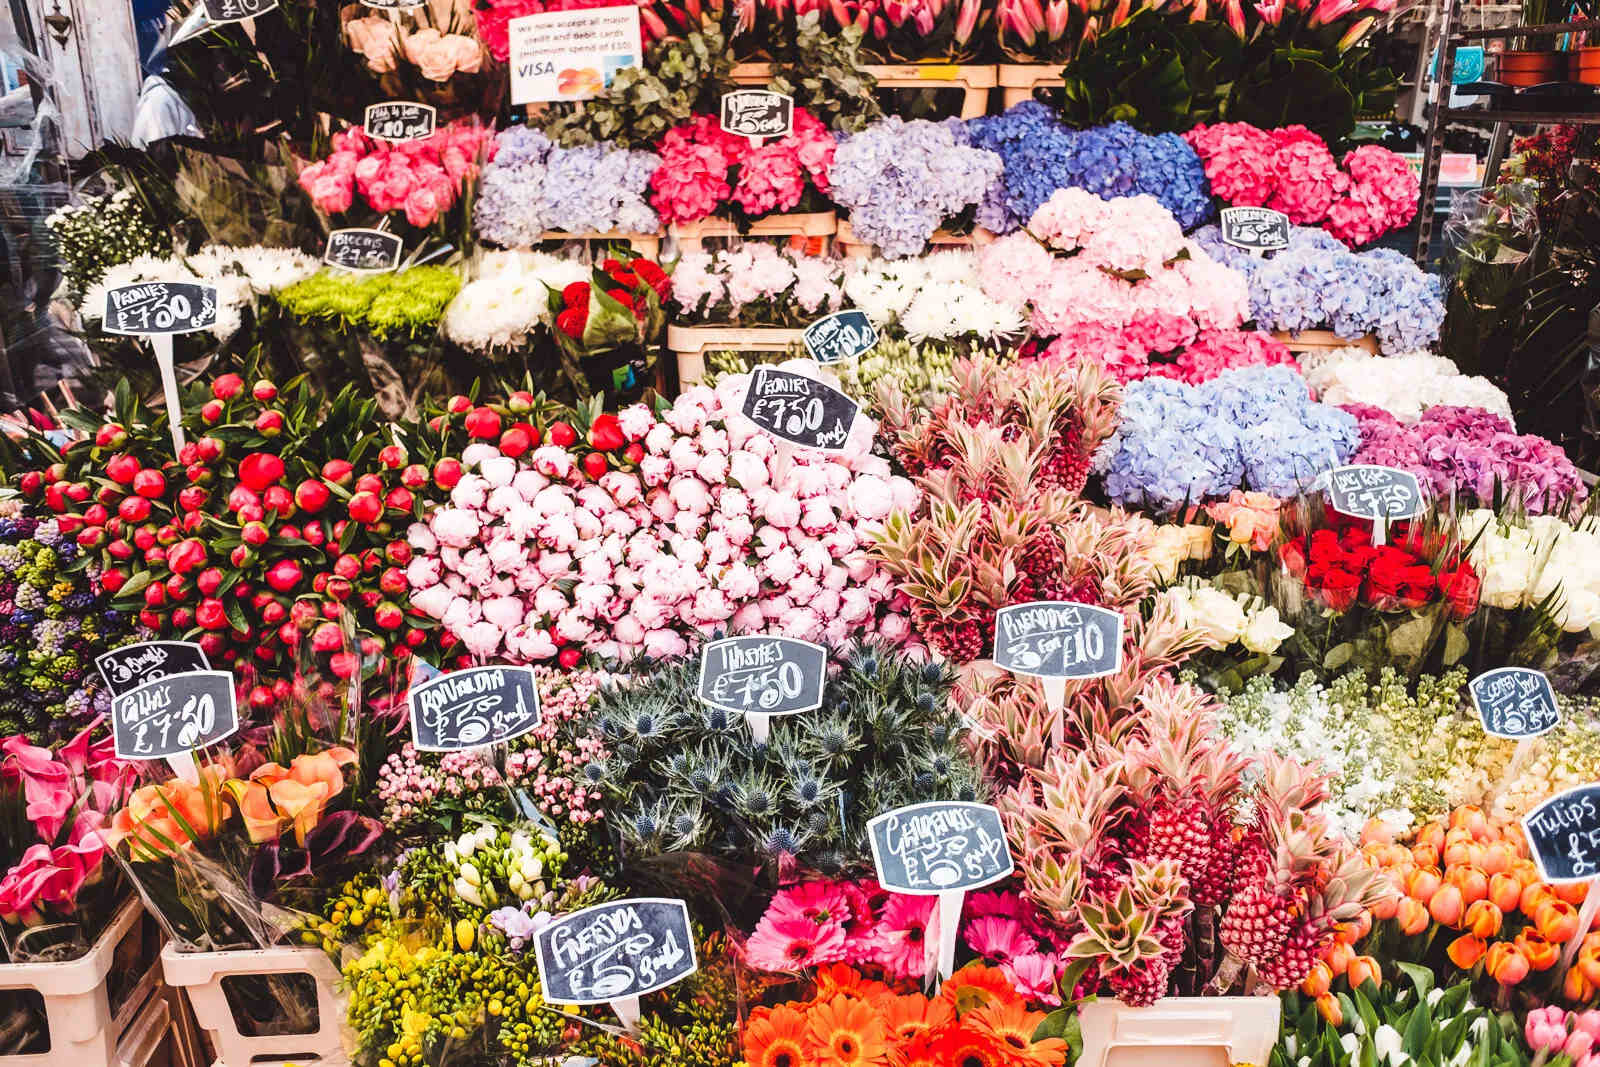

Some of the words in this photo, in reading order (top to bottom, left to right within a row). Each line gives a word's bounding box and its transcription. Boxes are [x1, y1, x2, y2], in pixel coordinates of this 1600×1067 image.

[557, 18, 586, 29] accept
[590, 16, 600, 25] all
[553, 32, 570, 41] and
[573, 30, 596, 40] debit
[600, 30, 625, 39] cards
[518, 61, 555, 79] VISA
[1063, 623, 1105, 669] £10
[103, 656, 133, 683] 3
[1527, 796, 1597, 838] Tulips
